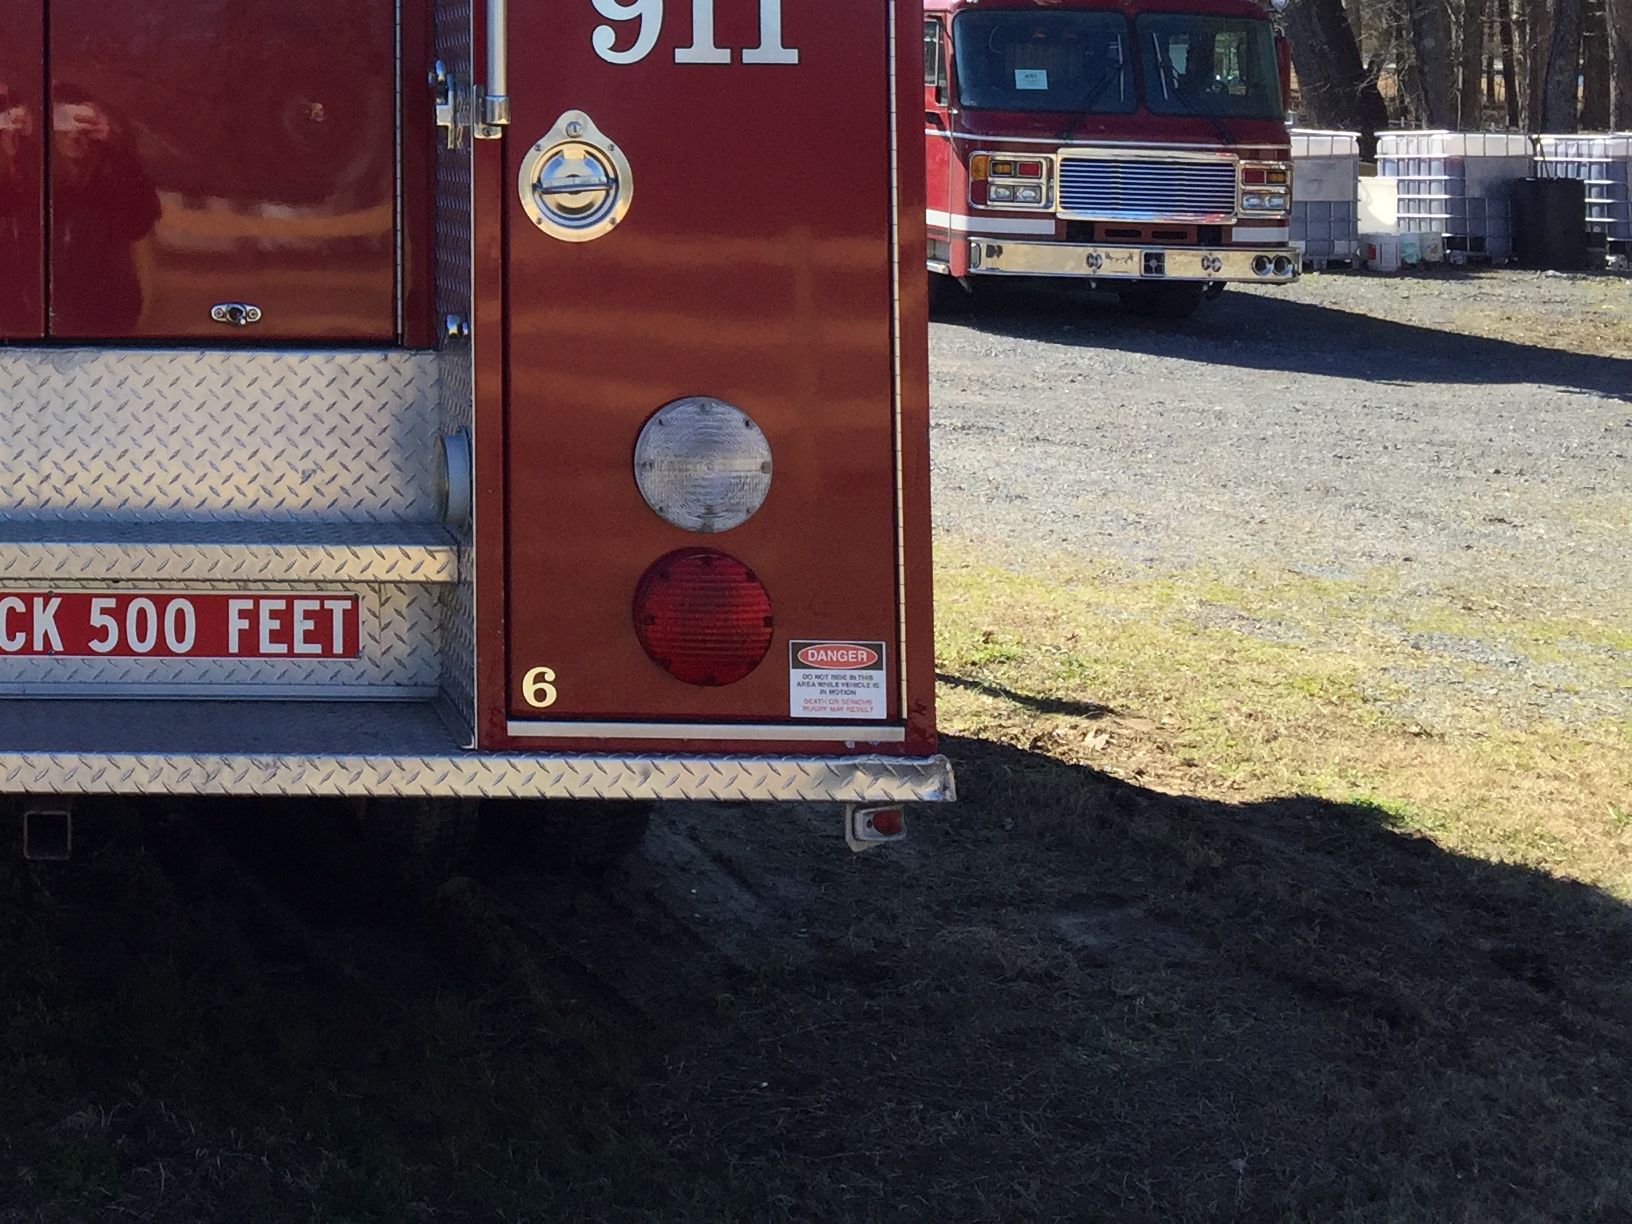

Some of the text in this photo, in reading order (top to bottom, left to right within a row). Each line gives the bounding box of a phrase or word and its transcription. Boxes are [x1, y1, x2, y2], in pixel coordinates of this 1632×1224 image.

[88, 597, 196, 653] 500
[228, 599, 352, 654] FEET
[808, 650, 867, 662] DANGER
[522, 667, 557, 708] 6
